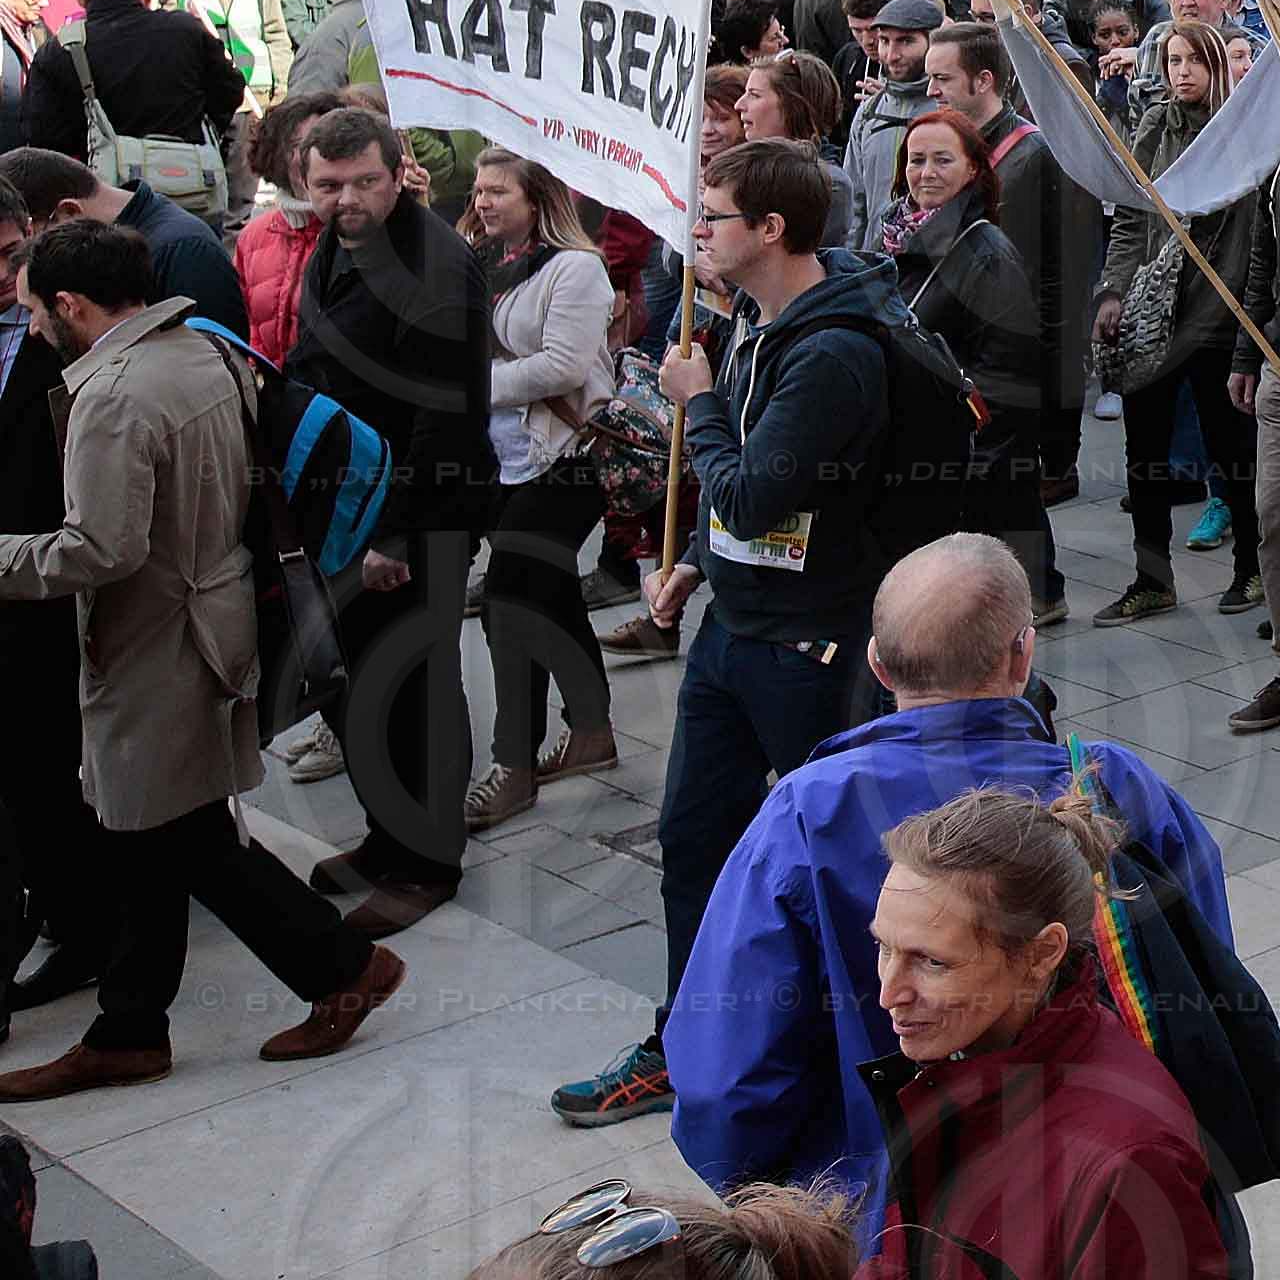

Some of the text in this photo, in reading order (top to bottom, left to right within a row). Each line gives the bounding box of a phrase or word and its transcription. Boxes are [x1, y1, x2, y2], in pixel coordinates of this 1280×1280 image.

[580, 0, 697, 144] RECH
[543, 118, 565, 141] VIP
[574, 128, 600, 156] VERY
[608, 140, 644, 175] PERCENT
